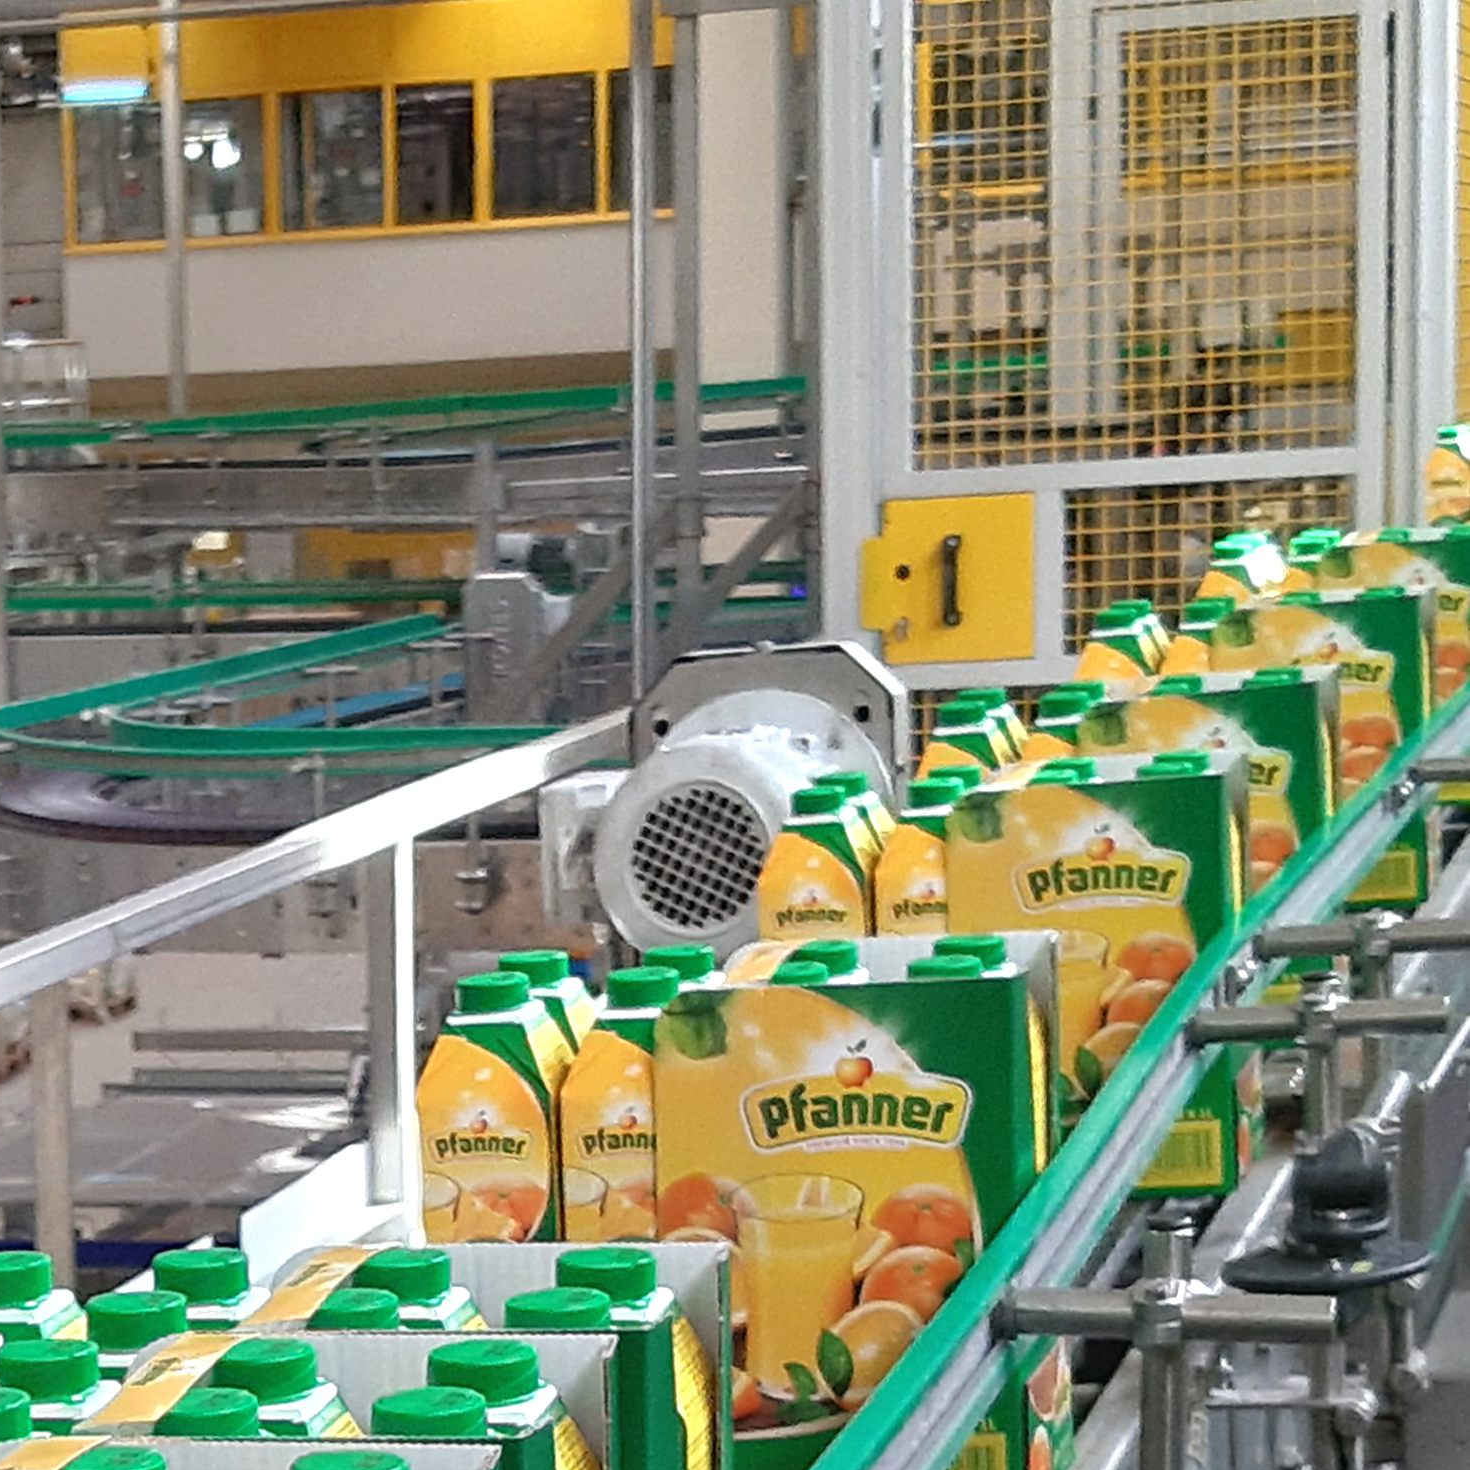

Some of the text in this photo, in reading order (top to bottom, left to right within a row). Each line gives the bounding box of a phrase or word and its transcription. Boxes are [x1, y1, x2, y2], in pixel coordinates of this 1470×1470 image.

[1026, 857, 1178, 903] pfanner
[757, 1082, 954, 1140] pfanner
[434, 1131, 527, 1158] pfanner
